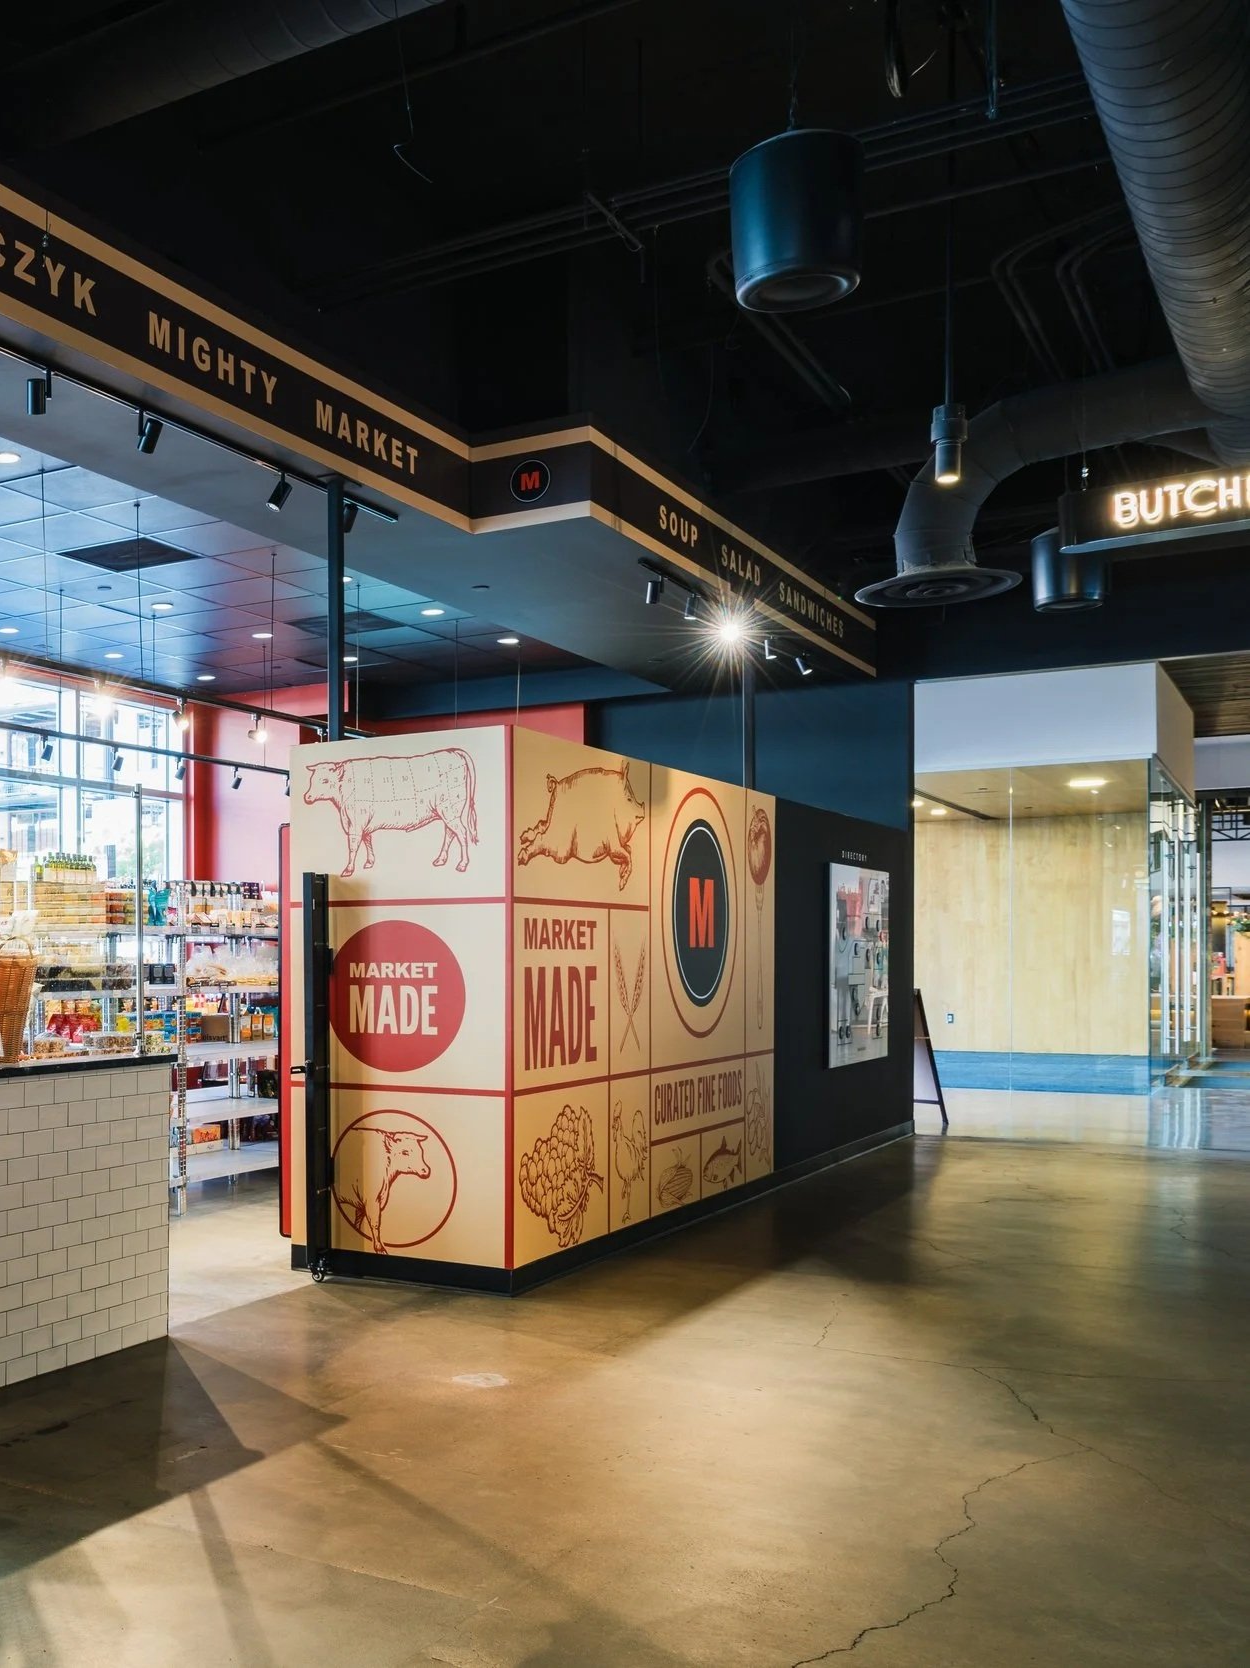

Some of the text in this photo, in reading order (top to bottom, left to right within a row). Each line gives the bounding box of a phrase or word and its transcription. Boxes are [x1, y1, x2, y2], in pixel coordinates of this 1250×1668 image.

[149, 311, 277, 405] MIGHTY
[316, 399, 418, 475] MARKET
[520, 471, 540, 491] M
[1114, 475, 1250, 529] BUTCH
[659, 504, 845, 638] SOUP SALAD SANDWICHES
[841, 850, 867, 862] DIRECTORY
[524, 917, 598, 950] MARKET
[689, 876, 715, 949] M
[349, 962, 438, 980] MARKET
[349, 984, 439, 1036] MADE
[524, 965, 598, 1071] MADE
[654, 1069, 743, 1126] CURATED FINE FOODS
